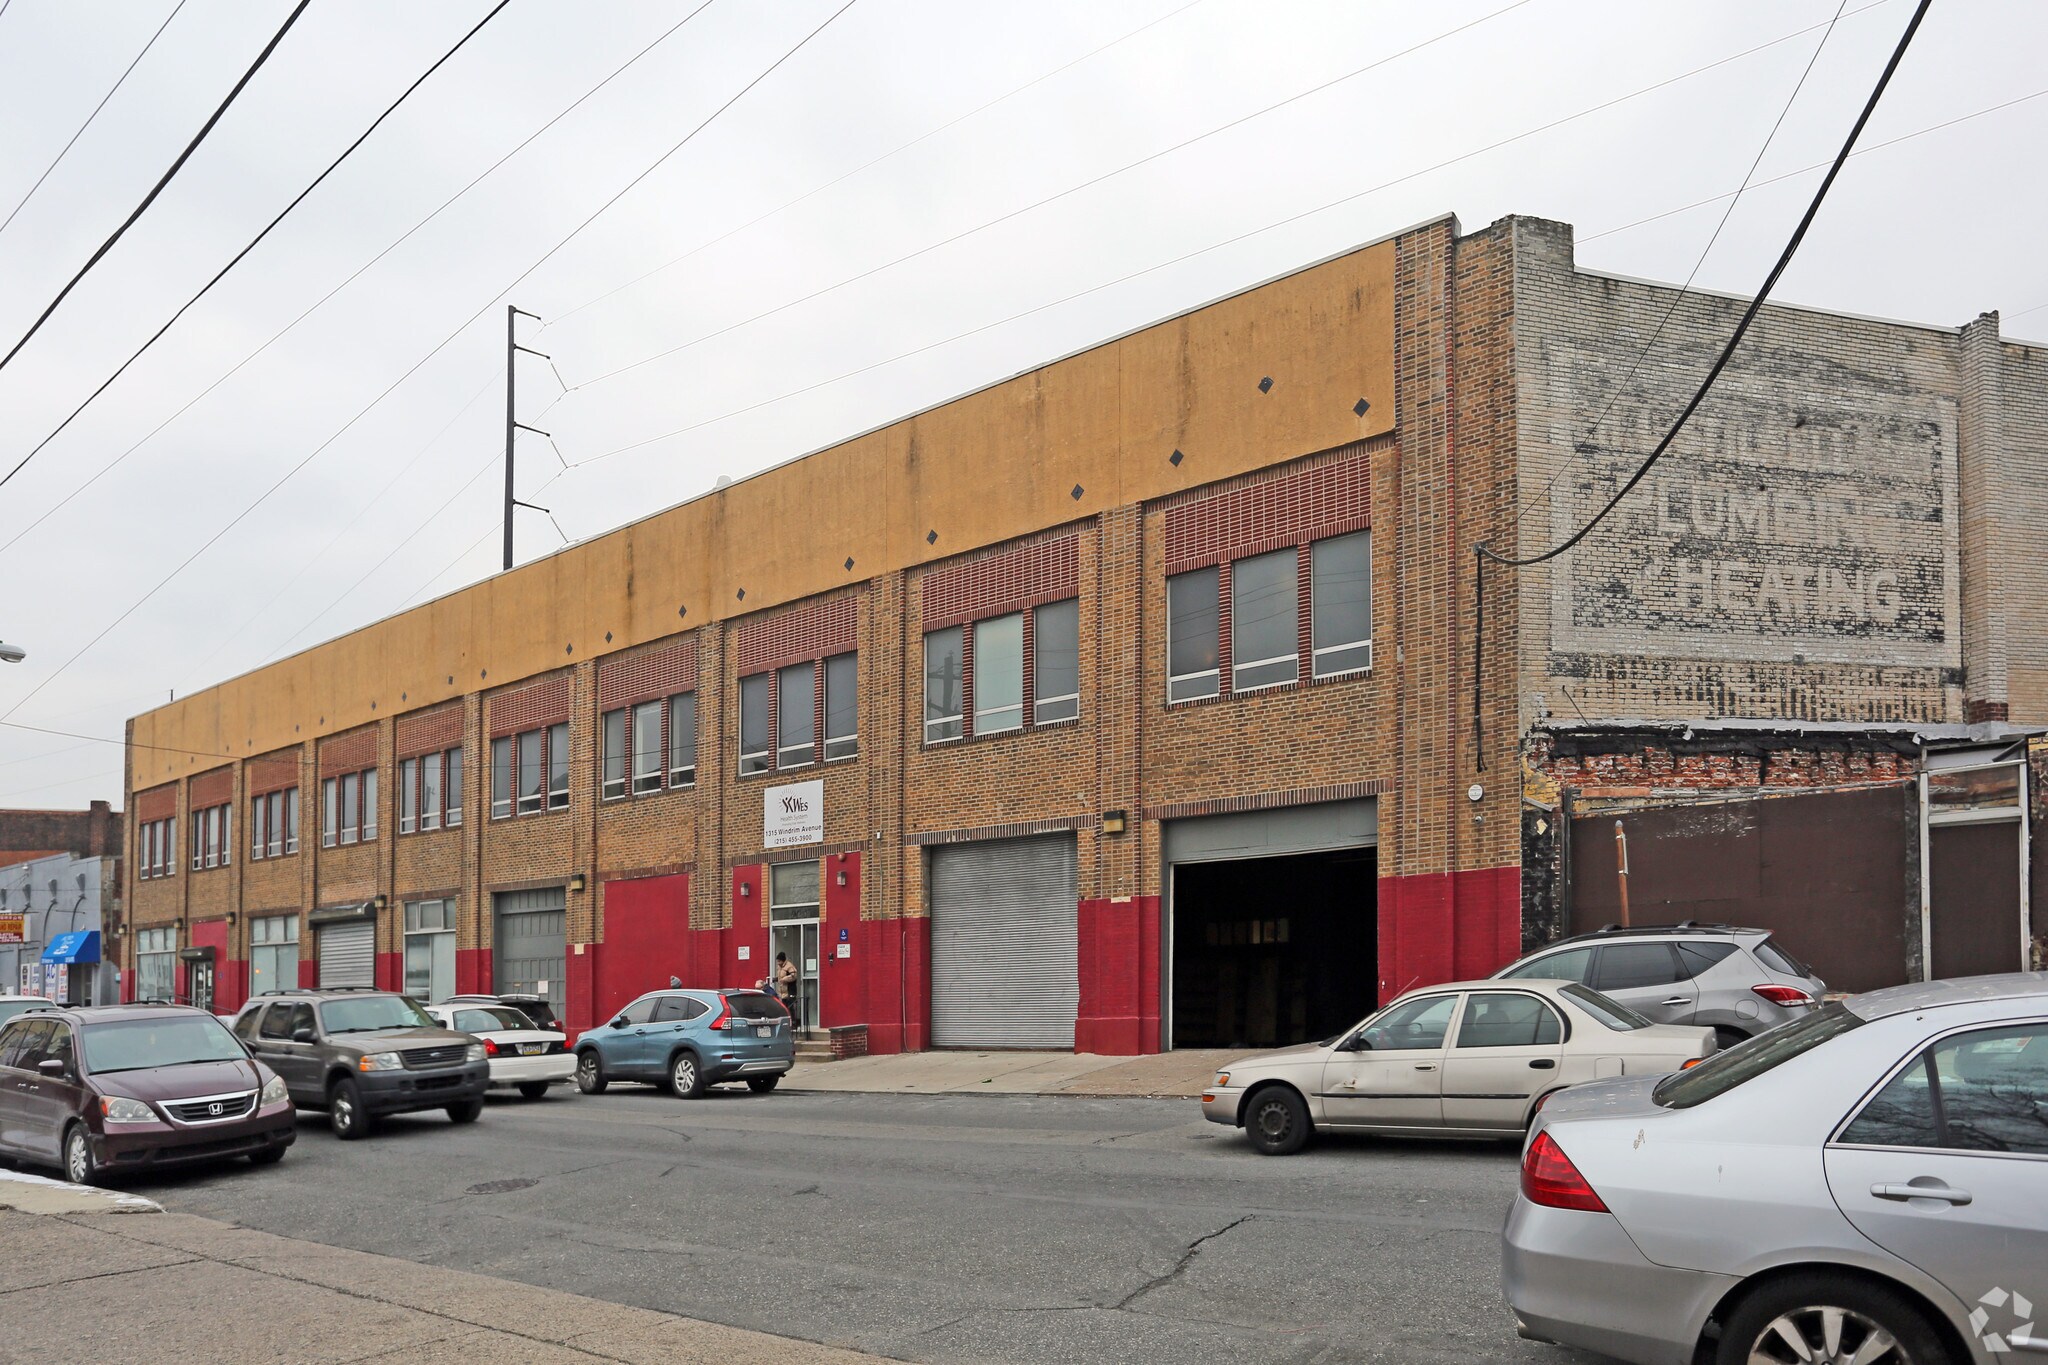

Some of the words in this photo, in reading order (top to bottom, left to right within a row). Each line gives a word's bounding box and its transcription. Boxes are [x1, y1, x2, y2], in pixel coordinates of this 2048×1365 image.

[1677, 558, 1901, 622] HEATING
[765, 829, 778, 837] 1315
[778, 827, 800, 835] Windrim
[774, 837, 788, 845] (215)
